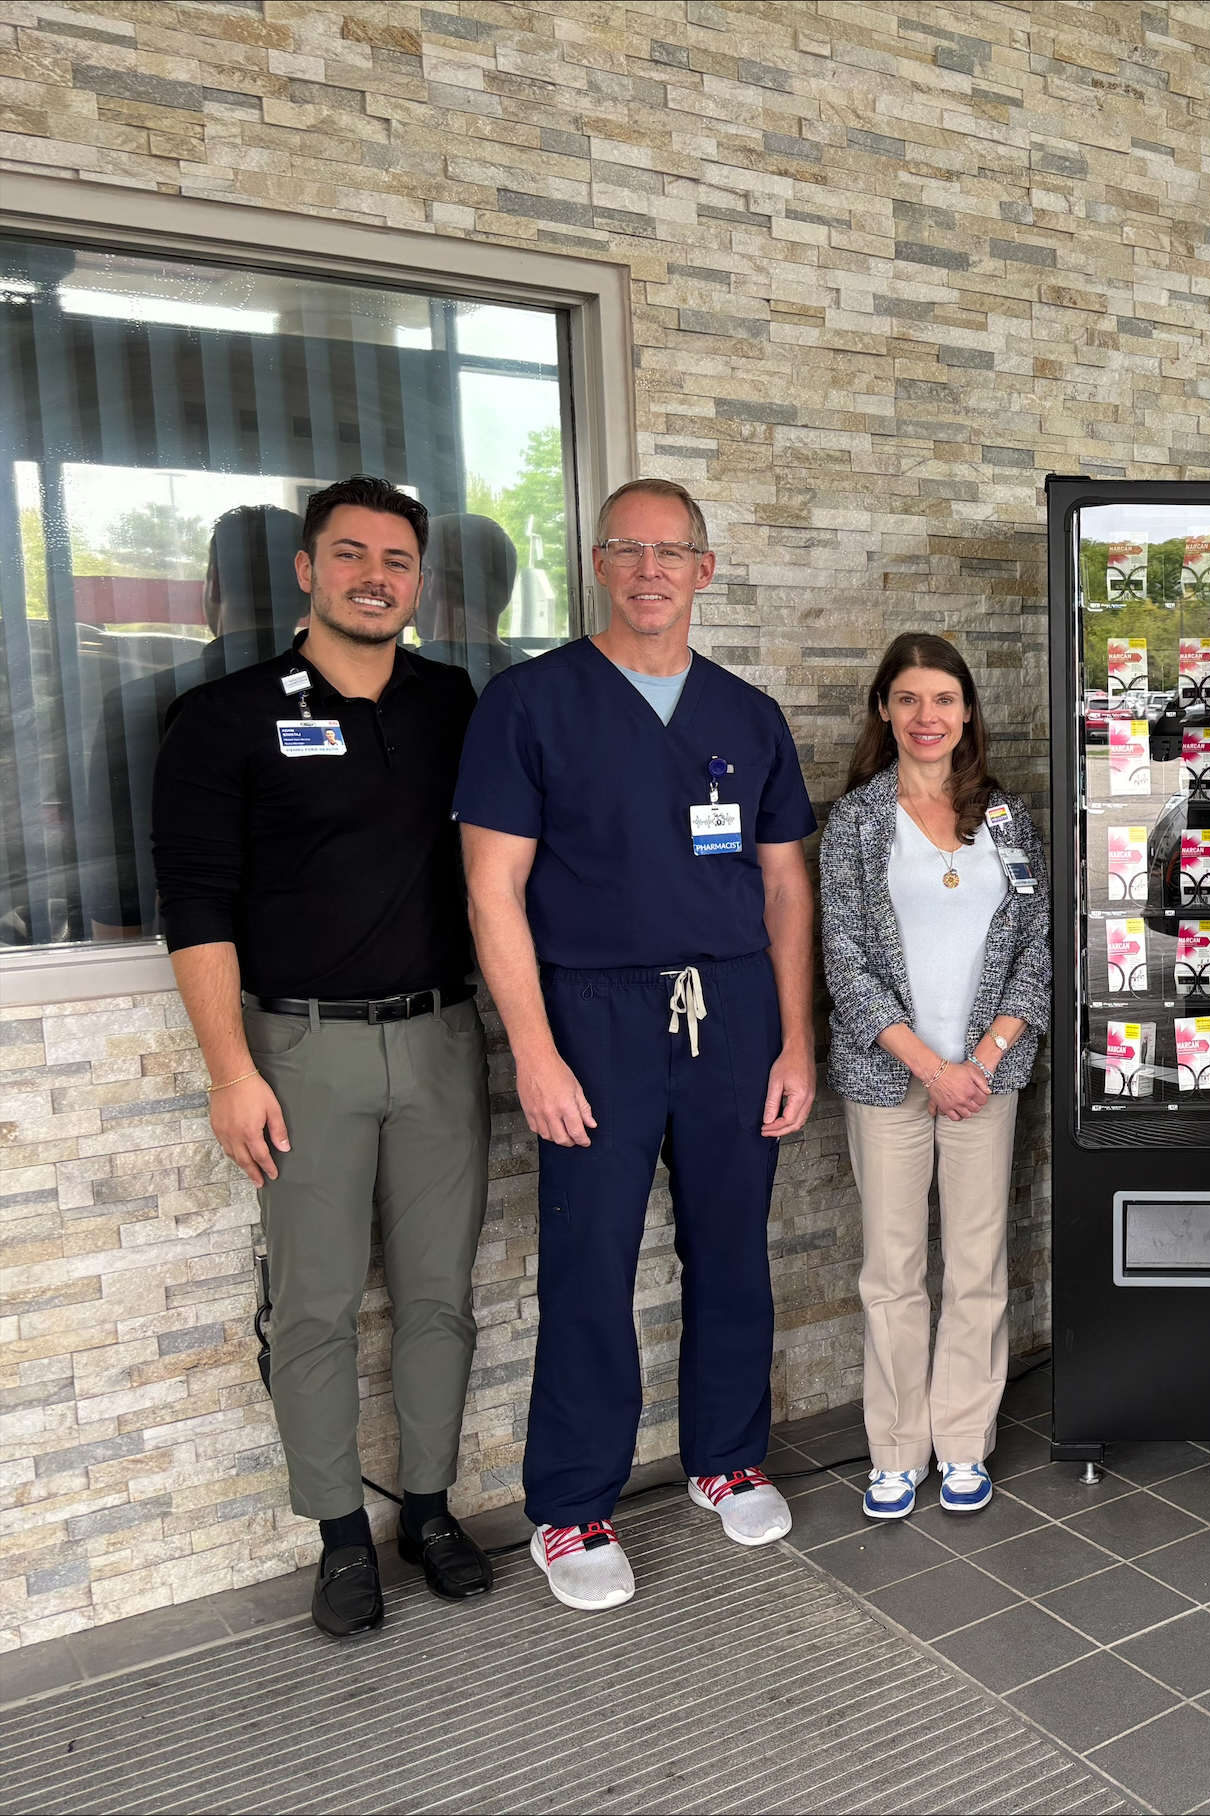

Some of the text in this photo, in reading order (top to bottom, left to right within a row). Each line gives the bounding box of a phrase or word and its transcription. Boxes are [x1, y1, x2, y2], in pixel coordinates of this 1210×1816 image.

[1110, 744, 1134, 752] NARCAN
[696, 841, 740, 852] PHARMACIST
[1107, 1045, 1126, 1054] NARCAN
